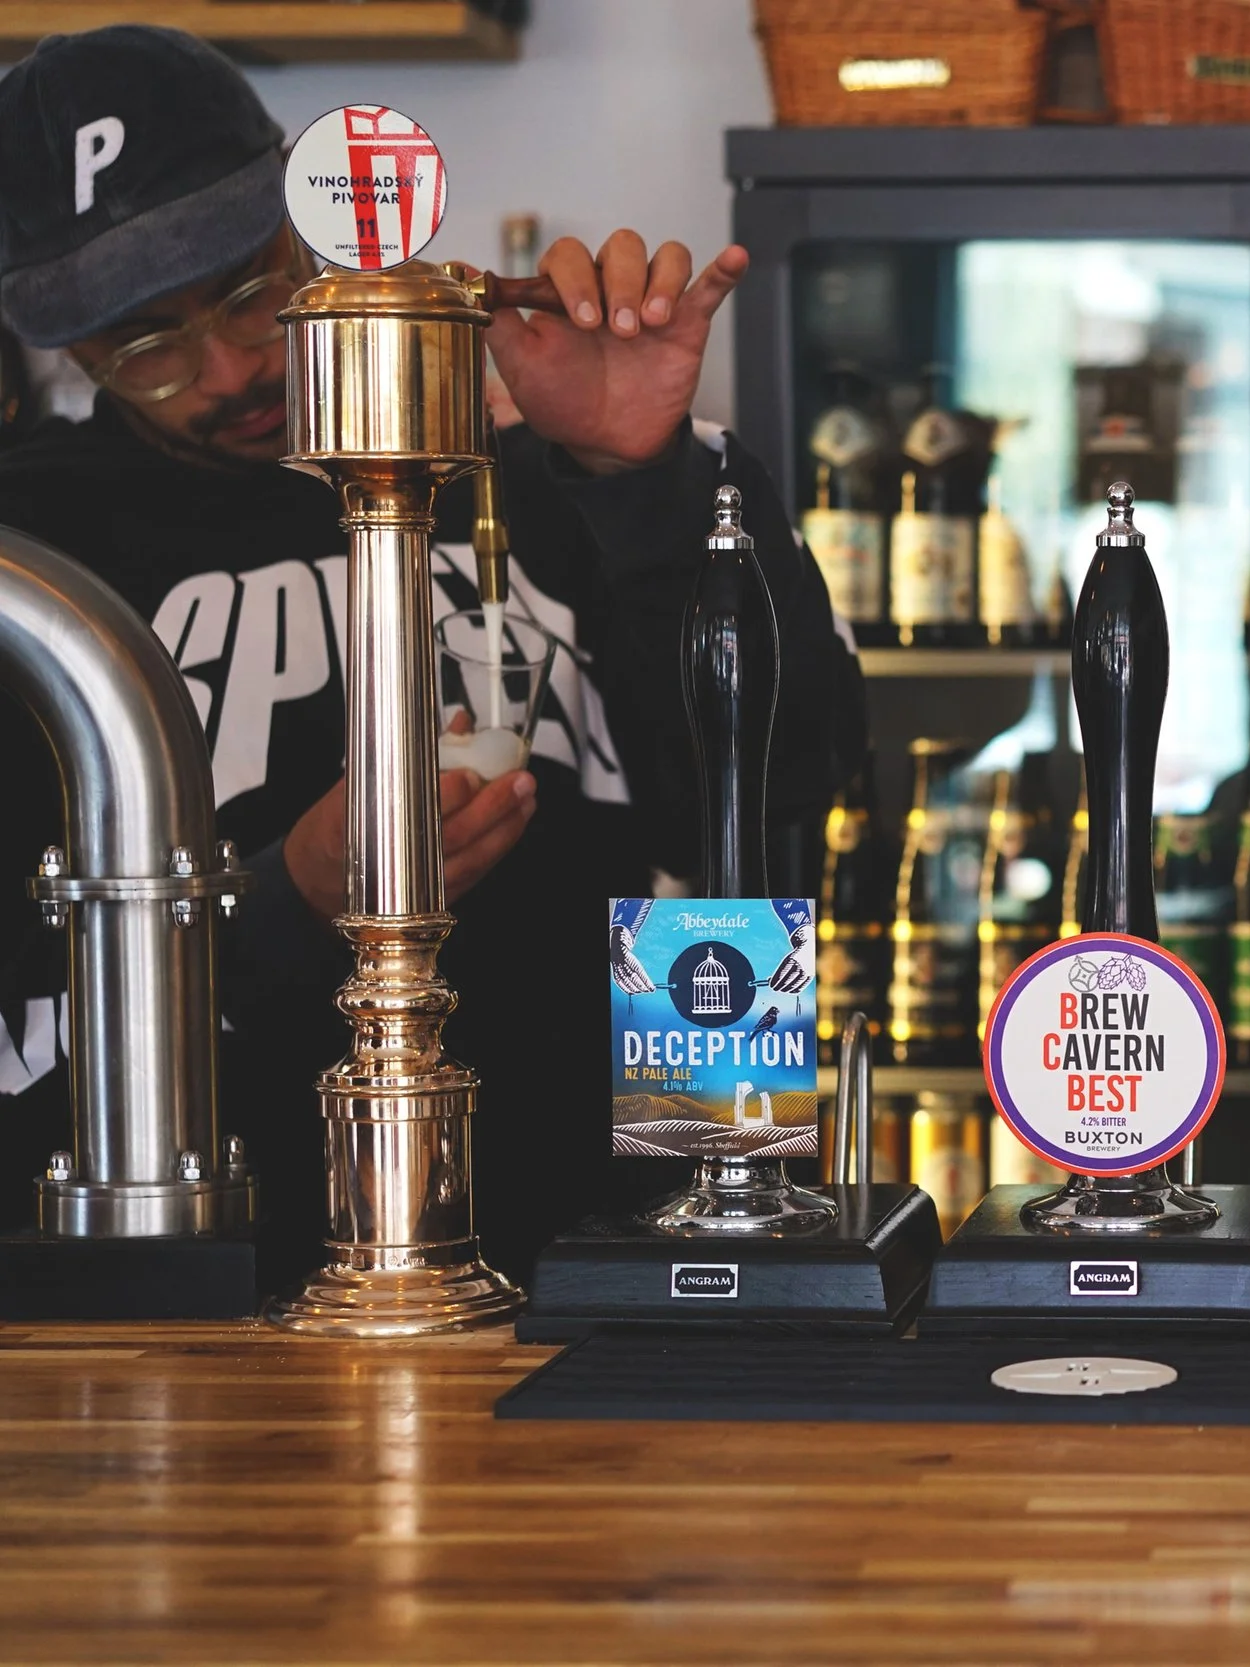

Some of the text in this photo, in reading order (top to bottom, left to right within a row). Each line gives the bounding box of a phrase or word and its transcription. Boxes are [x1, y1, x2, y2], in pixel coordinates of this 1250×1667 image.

[75, 115, 125, 214] P
[308, 173, 424, 188] VINOHRADSKÝ
[332, 192, 401, 205] PIVOVAR
[357, 218, 376, 239] 11
[672, 911, 750, 932] Abbeydale
[693, 929, 735, 938] BREWERY
[1060, 992, 1149, 1030] BREW
[623, 1030, 804, 1067] DECEPTION
[1043, 1032, 1165, 1072] CAVERN
[624, 1067, 692, 1080] NZ PALE ALE
[663, 1080, 704, 1091] 4.1% ABV
[1067, 1074, 1142, 1112] BEST
[1081, 1117, 1127, 1127] 4.2% BITTER
[1065, 1131, 1143, 1145] BUXTON
[678, 1276, 731, 1286] ANGRAM
[1077, 1273, 1131, 1283] ANGRAM
